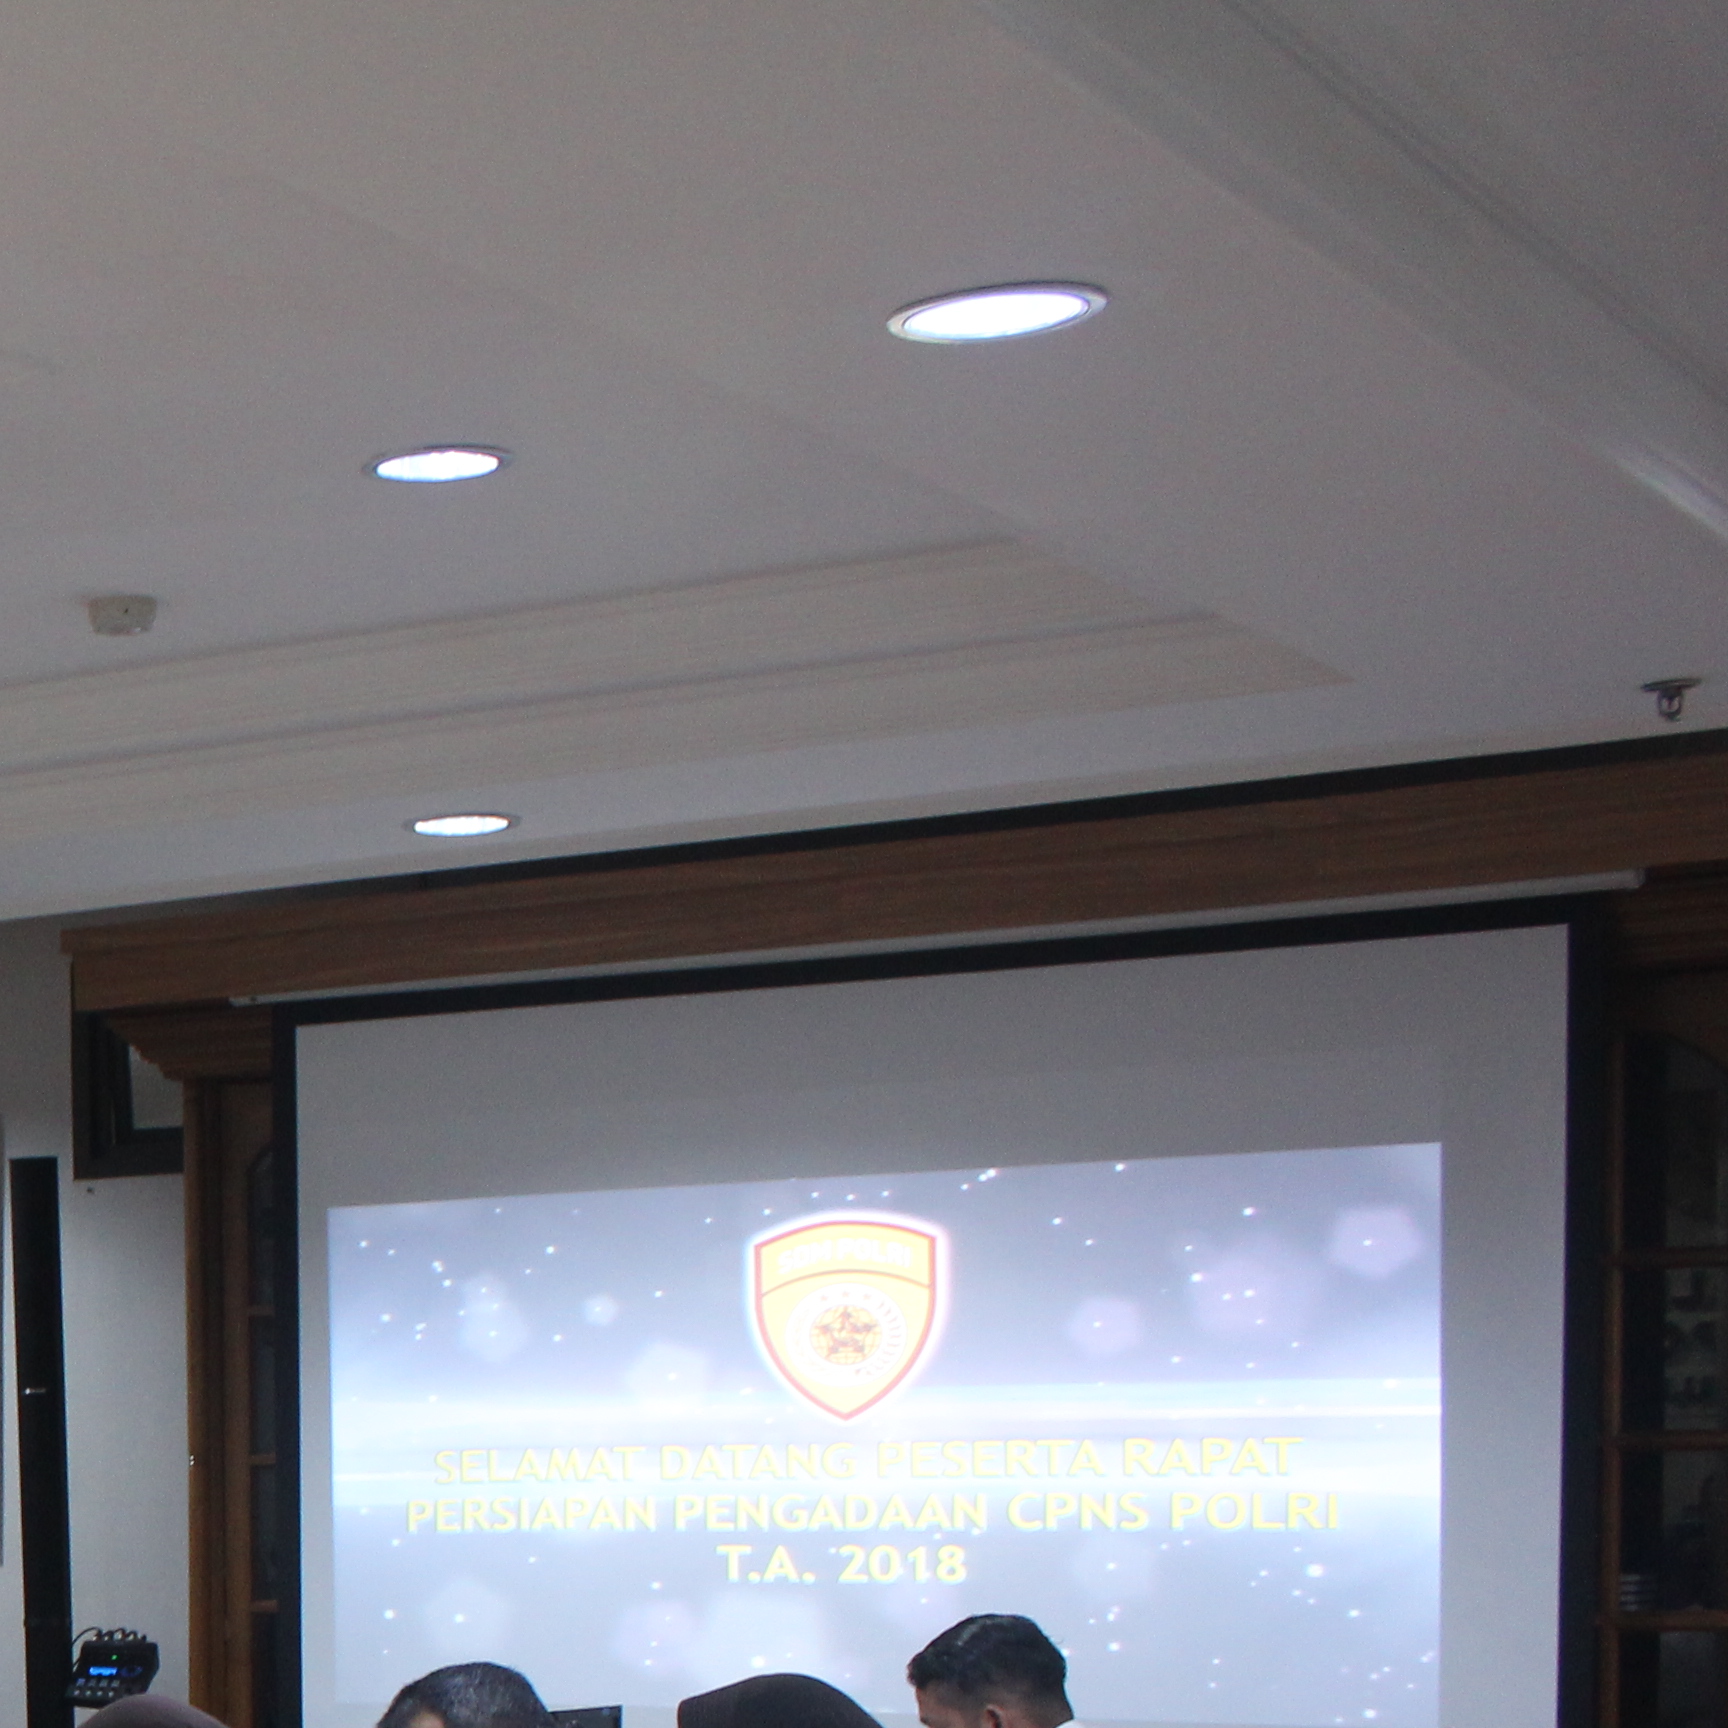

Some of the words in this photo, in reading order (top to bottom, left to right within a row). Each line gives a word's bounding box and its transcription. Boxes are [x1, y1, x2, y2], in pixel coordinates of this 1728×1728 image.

[778, 1240, 833, 1274] SDM
[837, 1238, 912, 1267] POLRI
[435, 1446, 646, 1484] SELAMAT
[660, 1443, 855, 1481] DATANG
[878, 1440, 1105, 1477] PESERTA
[1123, 1437, 1303, 1476] RAPAT
[407, 1497, 656, 1532] PERSIAPAN
[674, 1494, 987, 1532] PENGADAAN
[1008, 1493, 1149, 1531] CPNS
[1170, 1493, 1338, 1531] POLRI
[717, 1545, 815, 1583] T.A.
[838, 1545, 967, 1583] 2018
